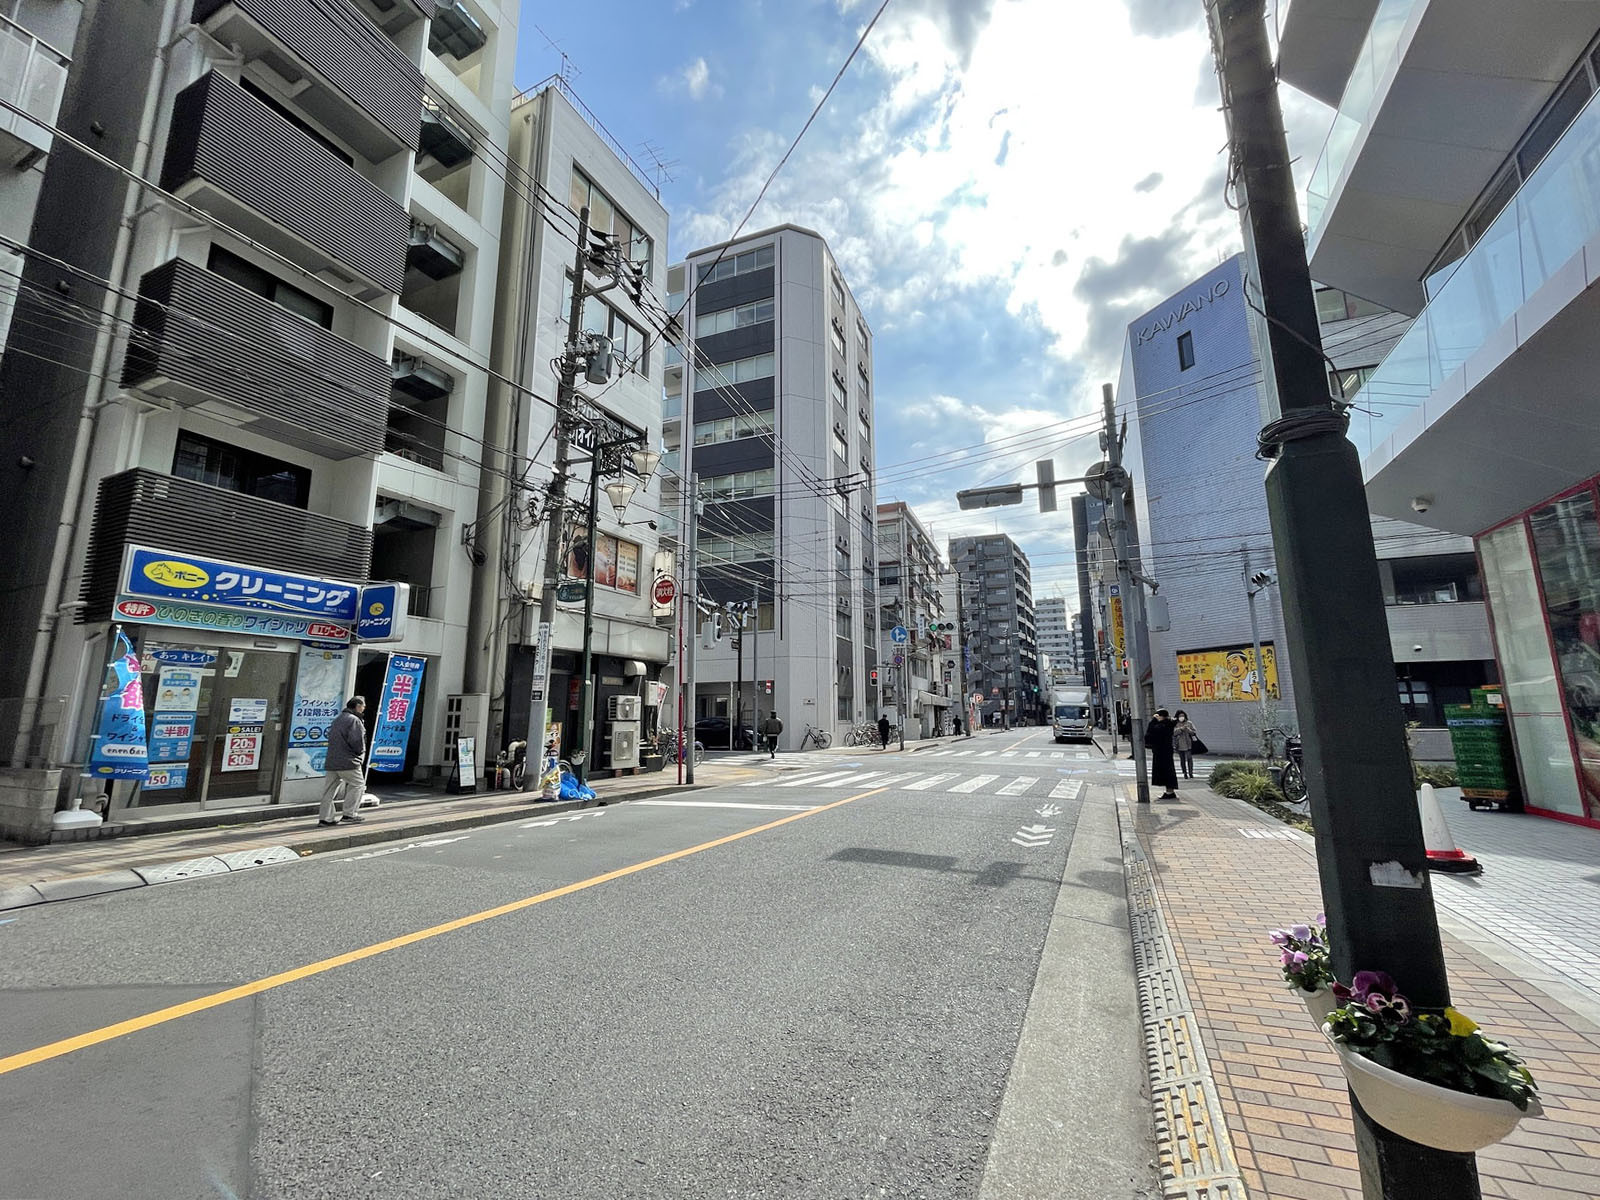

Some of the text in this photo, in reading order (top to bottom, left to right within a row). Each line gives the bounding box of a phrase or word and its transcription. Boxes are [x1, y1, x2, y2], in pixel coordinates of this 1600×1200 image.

[1137, 279, 1230, 346] KAWANO
[174, 570, 350, 607] ポニー クリーニング
[656, 587, 674, 598] 消火栓
[124, 603, 151, 616] 特許
[360, 617, 391, 627] クリーニング
[160, 651, 178, 660] あっ
[302, 699, 337, 707] ワイシャツ
[387, 673, 413, 722] 半額
[164, 725, 189, 737] 半額
[148, 775, 167, 785] 150
